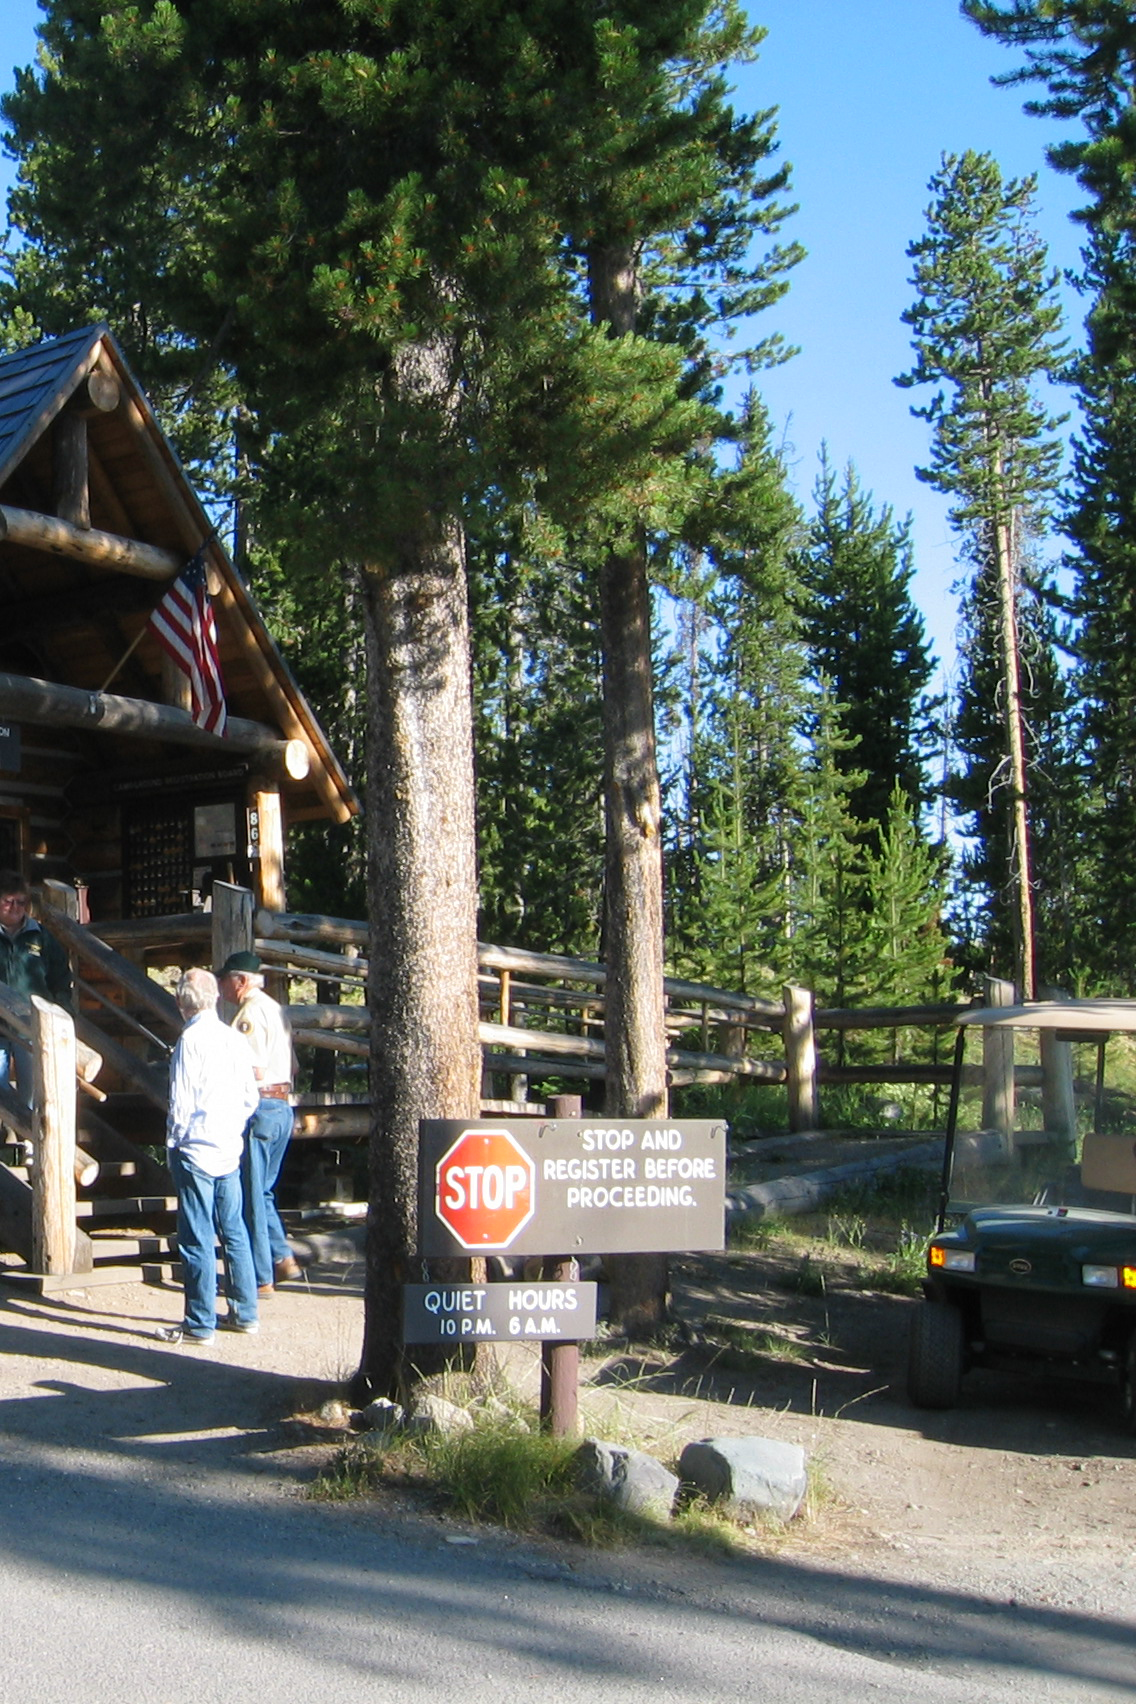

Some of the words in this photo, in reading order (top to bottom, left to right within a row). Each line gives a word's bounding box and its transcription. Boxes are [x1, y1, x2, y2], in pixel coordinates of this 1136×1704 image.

[582, 1129, 633, 1151] STOP
[641, 1129, 682, 1151] AND
[543, 1159, 635, 1181] REGISTER
[644, 1158, 716, 1179] BEFORE
[445, 1164, 527, 1210] STOP
[566, 1186, 697, 1208] PROCEEDING.
[424, 1290, 486, 1314] QUIET
[509, 1289, 578, 1311] HOURS
[440, 1318, 456, 1335] 10
[509, 1317, 521, 1334] 6
